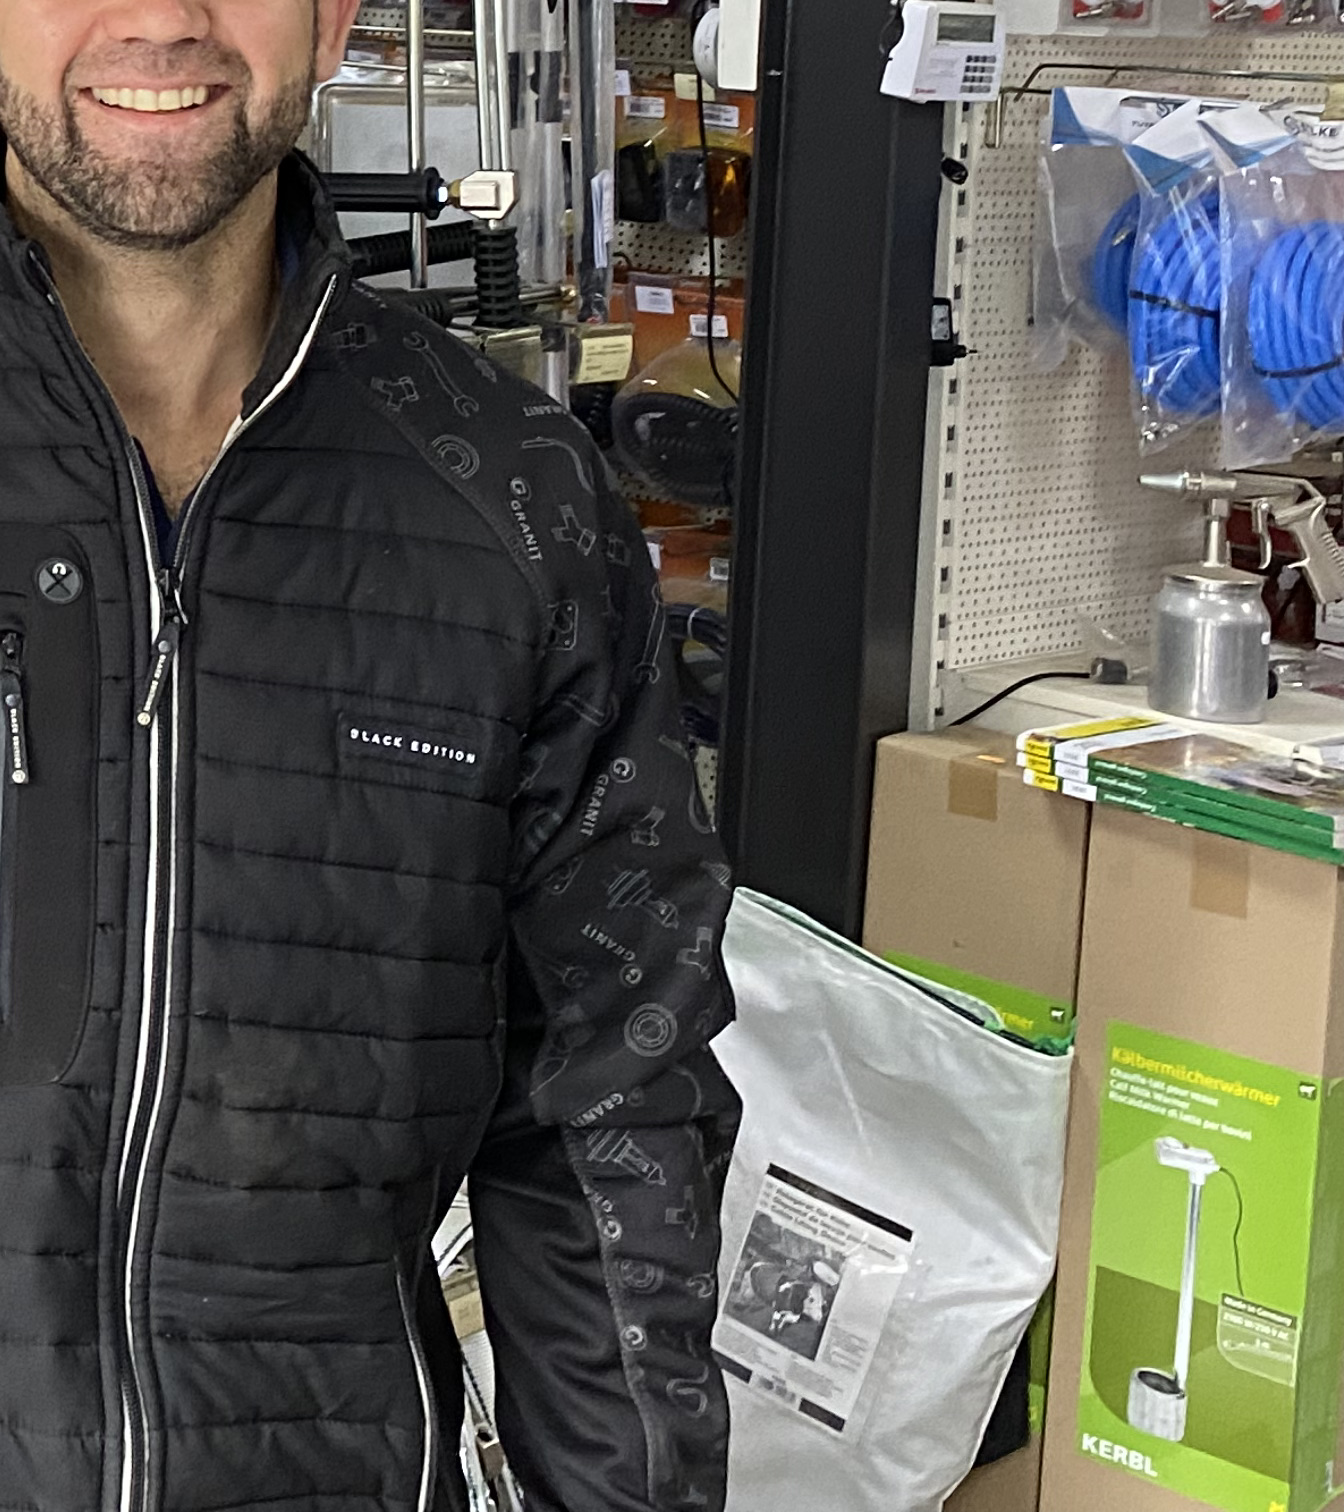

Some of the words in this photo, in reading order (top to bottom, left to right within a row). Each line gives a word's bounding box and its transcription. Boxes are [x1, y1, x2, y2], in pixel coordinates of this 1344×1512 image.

[510, 500, 543, 562] GRANIT
[350, 728, 403, 749] BLACK
[411, 740, 477, 764] EDITION
[579, 774, 609, 837] GRANIT
[581, 922, 636, 962] GRANIT
[1081, 1433, 1159, 1477] KERBL
